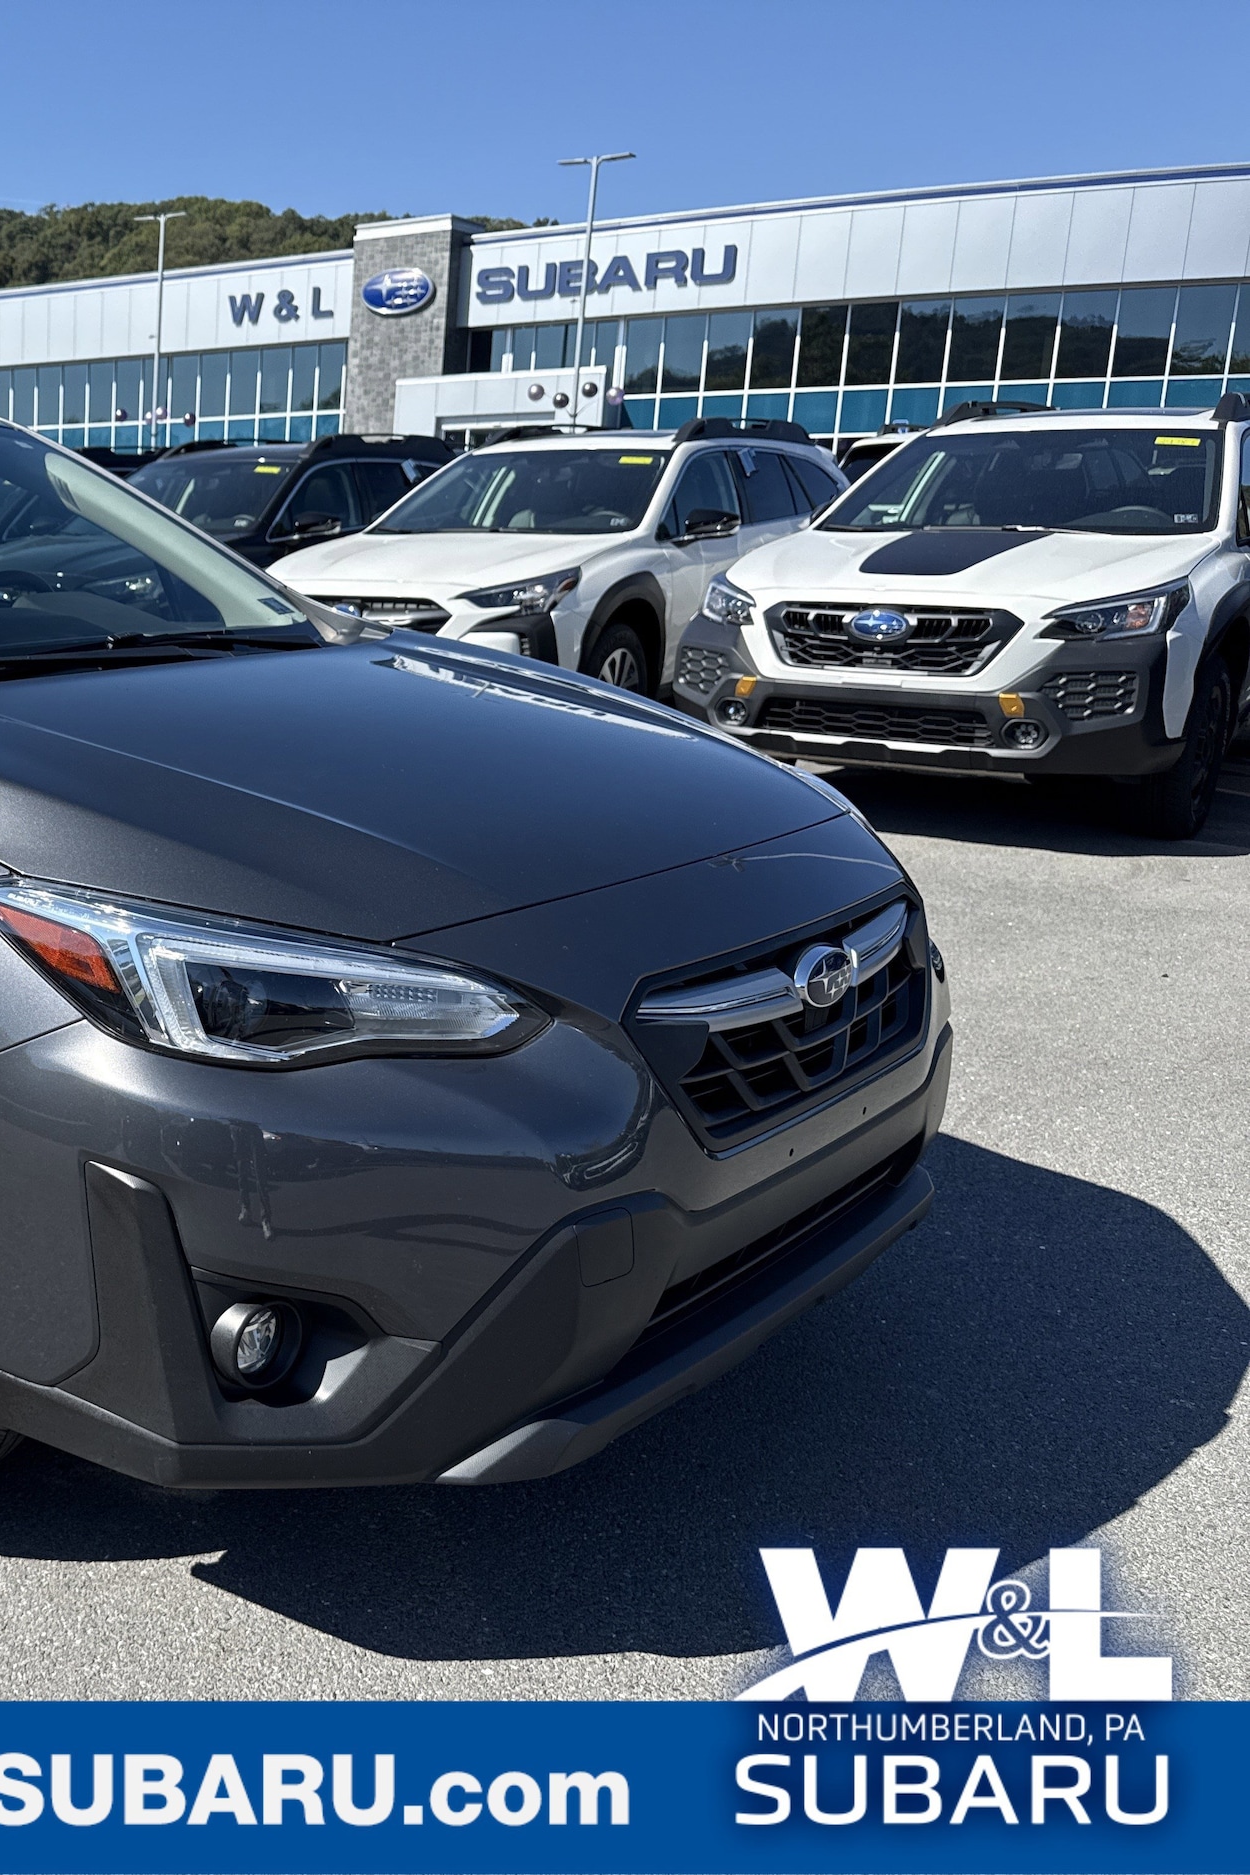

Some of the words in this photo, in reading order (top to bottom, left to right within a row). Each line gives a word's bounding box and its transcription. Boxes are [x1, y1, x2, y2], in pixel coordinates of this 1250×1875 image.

[476, 244, 738, 304] SUBARU
[228, 292, 265, 327] W
[273, 289, 300, 323] &
[312, 286, 334, 319] L
